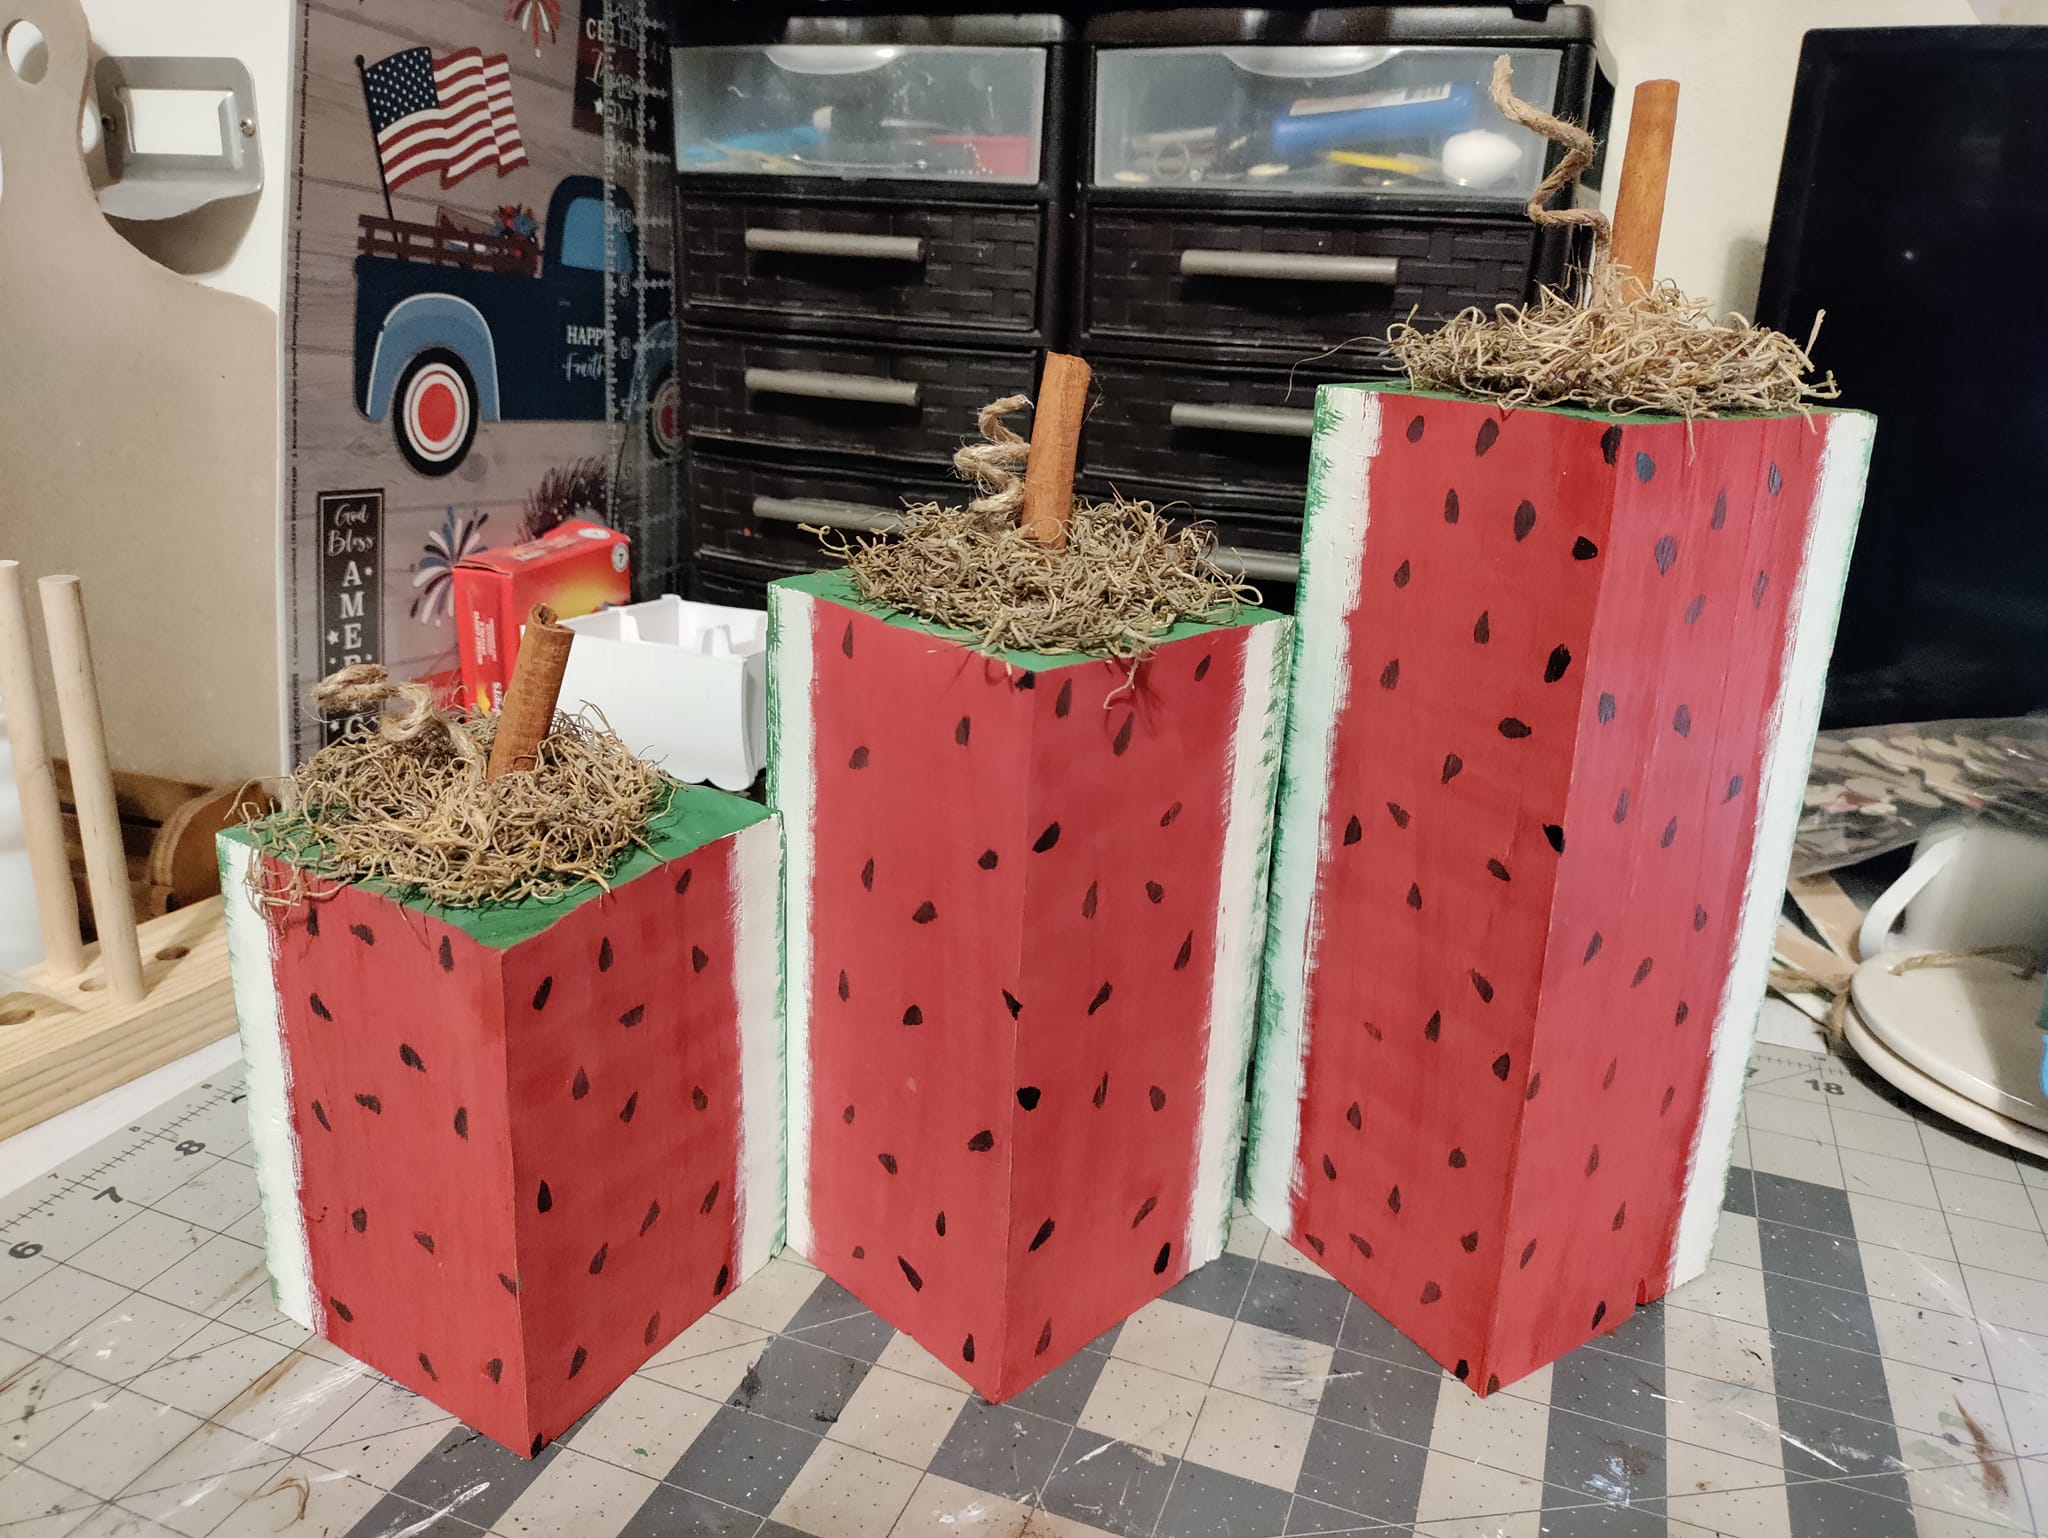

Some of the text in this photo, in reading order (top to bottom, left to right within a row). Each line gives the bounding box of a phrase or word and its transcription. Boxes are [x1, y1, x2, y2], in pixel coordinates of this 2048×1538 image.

[616, 208, 634, 233] 10
[619, 274, 631, 297] 9
[619, 336, 632, 360] 8
[334, 503, 369, 527] God
[328, 529, 376, 557] Bless
[1804, 1079, 1845, 1095] 18
[175, 1139, 206, 1157] 8
[92, 1185, 124, 1204] 7
[8, 1240, 44, 1260] 6
